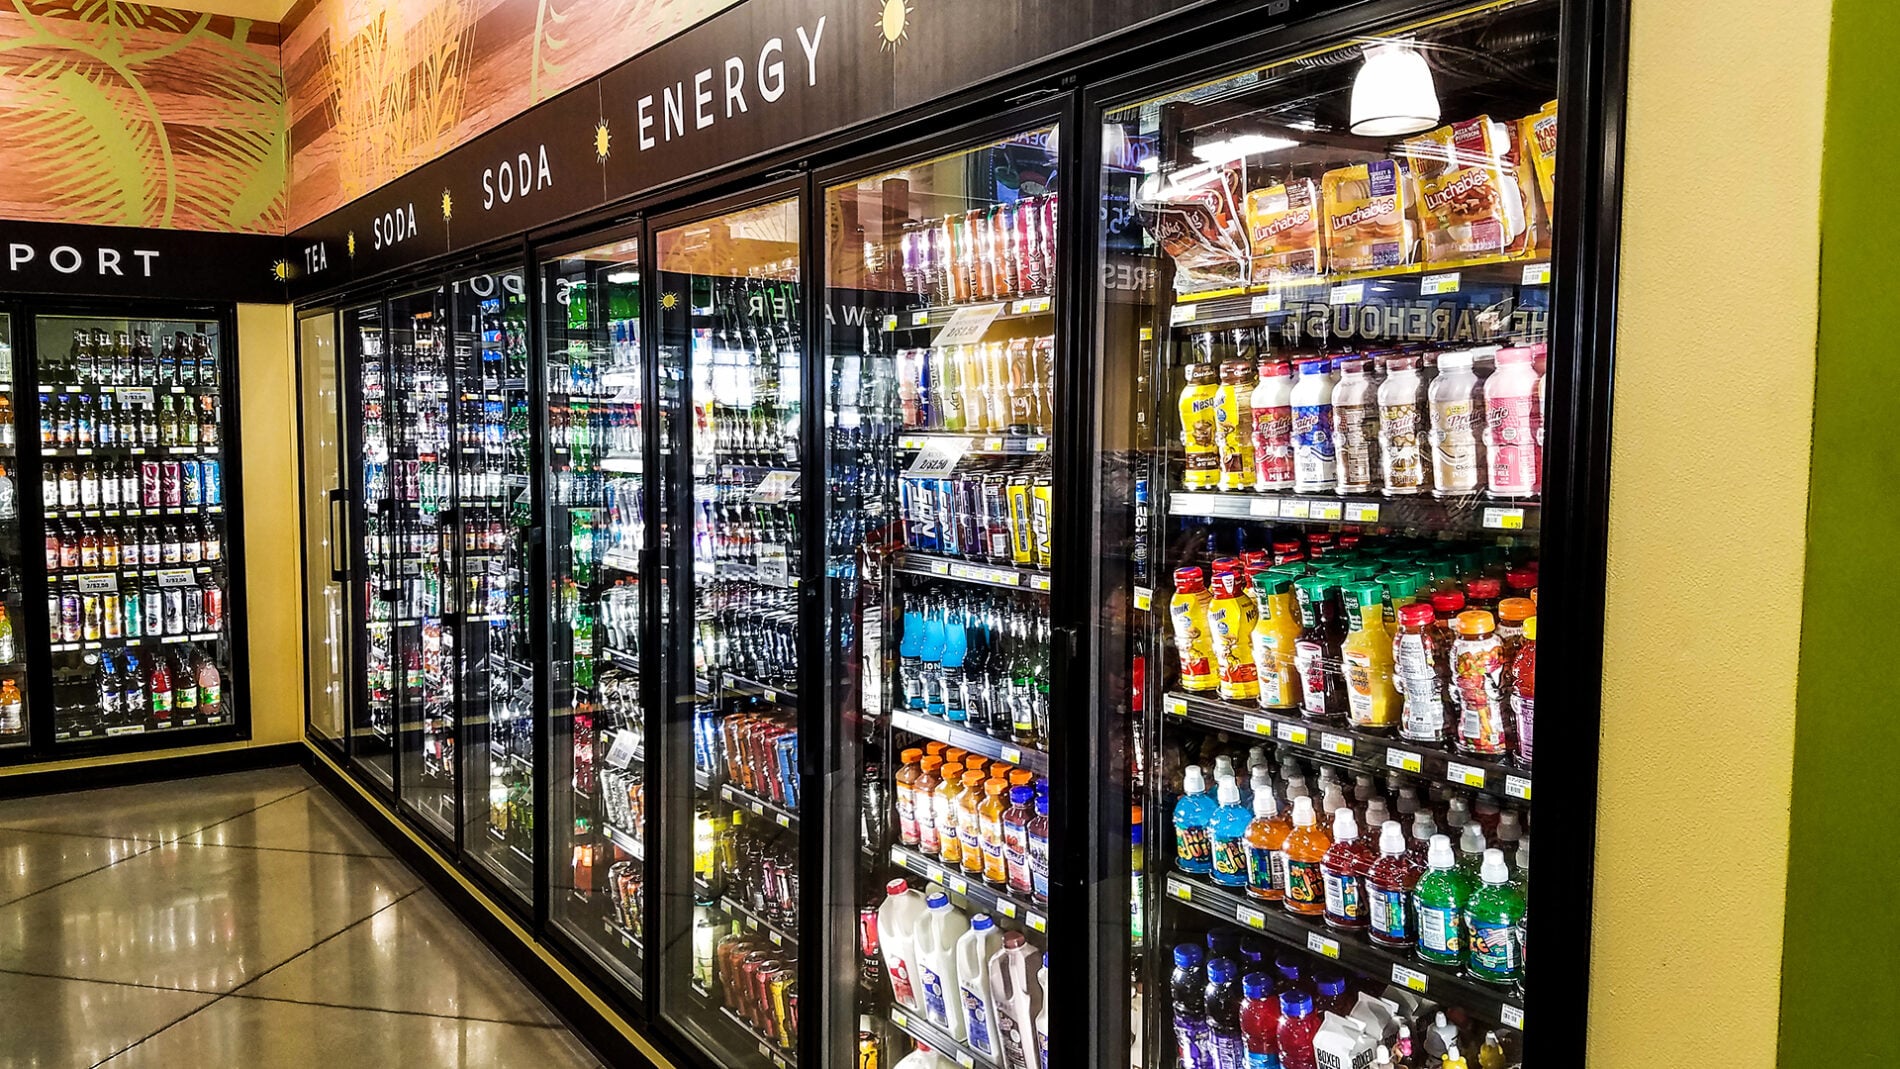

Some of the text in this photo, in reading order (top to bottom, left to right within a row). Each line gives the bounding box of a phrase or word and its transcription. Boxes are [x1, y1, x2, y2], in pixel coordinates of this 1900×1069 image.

[637, 15, 827, 151] ENERGY
[482, 143, 553, 211] SODA
[1424, 168, 1490, 212] Lunchables
[373, 202, 418, 252] SODA
[1253, 209, 1311, 242] Lunchables
[1331, 198, 1396, 232] Lunchables
[9, 243, 160, 277] PORT
[305, 241, 328, 273] TEA
[1193, 396, 1215, 413] Nesq
[1269, 472, 1290, 480] MILK
[1316, 1047, 1341, 1069] BOXED
[1351, 1047, 1375, 1069] BOXED
